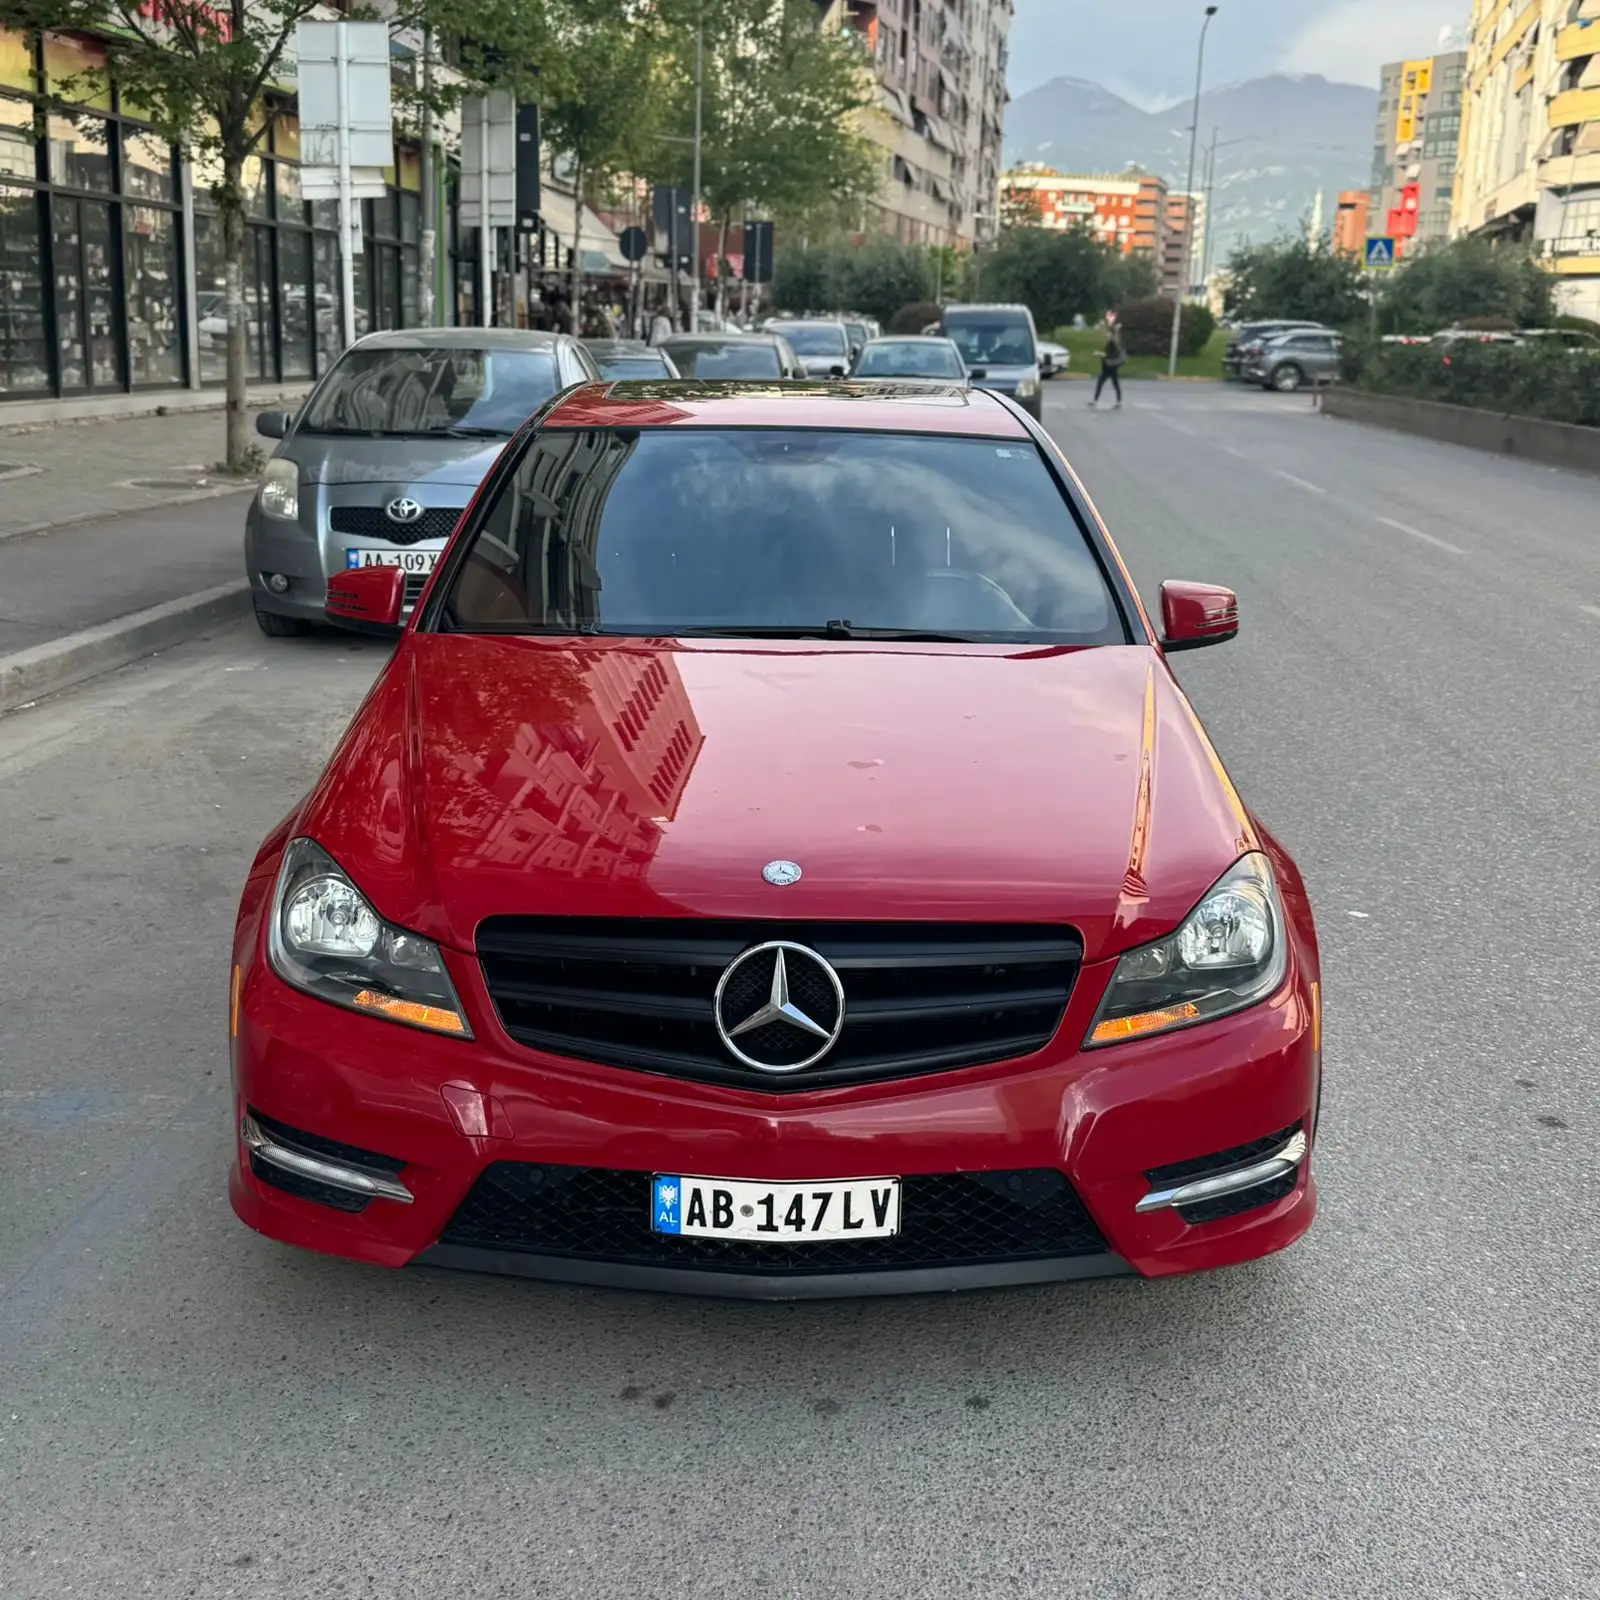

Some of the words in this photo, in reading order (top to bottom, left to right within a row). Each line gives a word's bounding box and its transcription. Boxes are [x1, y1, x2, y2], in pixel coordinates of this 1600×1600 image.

[394, 553, 425, 571] 109
[659, 1211, 678, 1223] AL
[686, 1187, 734, 1229] AB
[756, 1191, 834, 1232] 147
